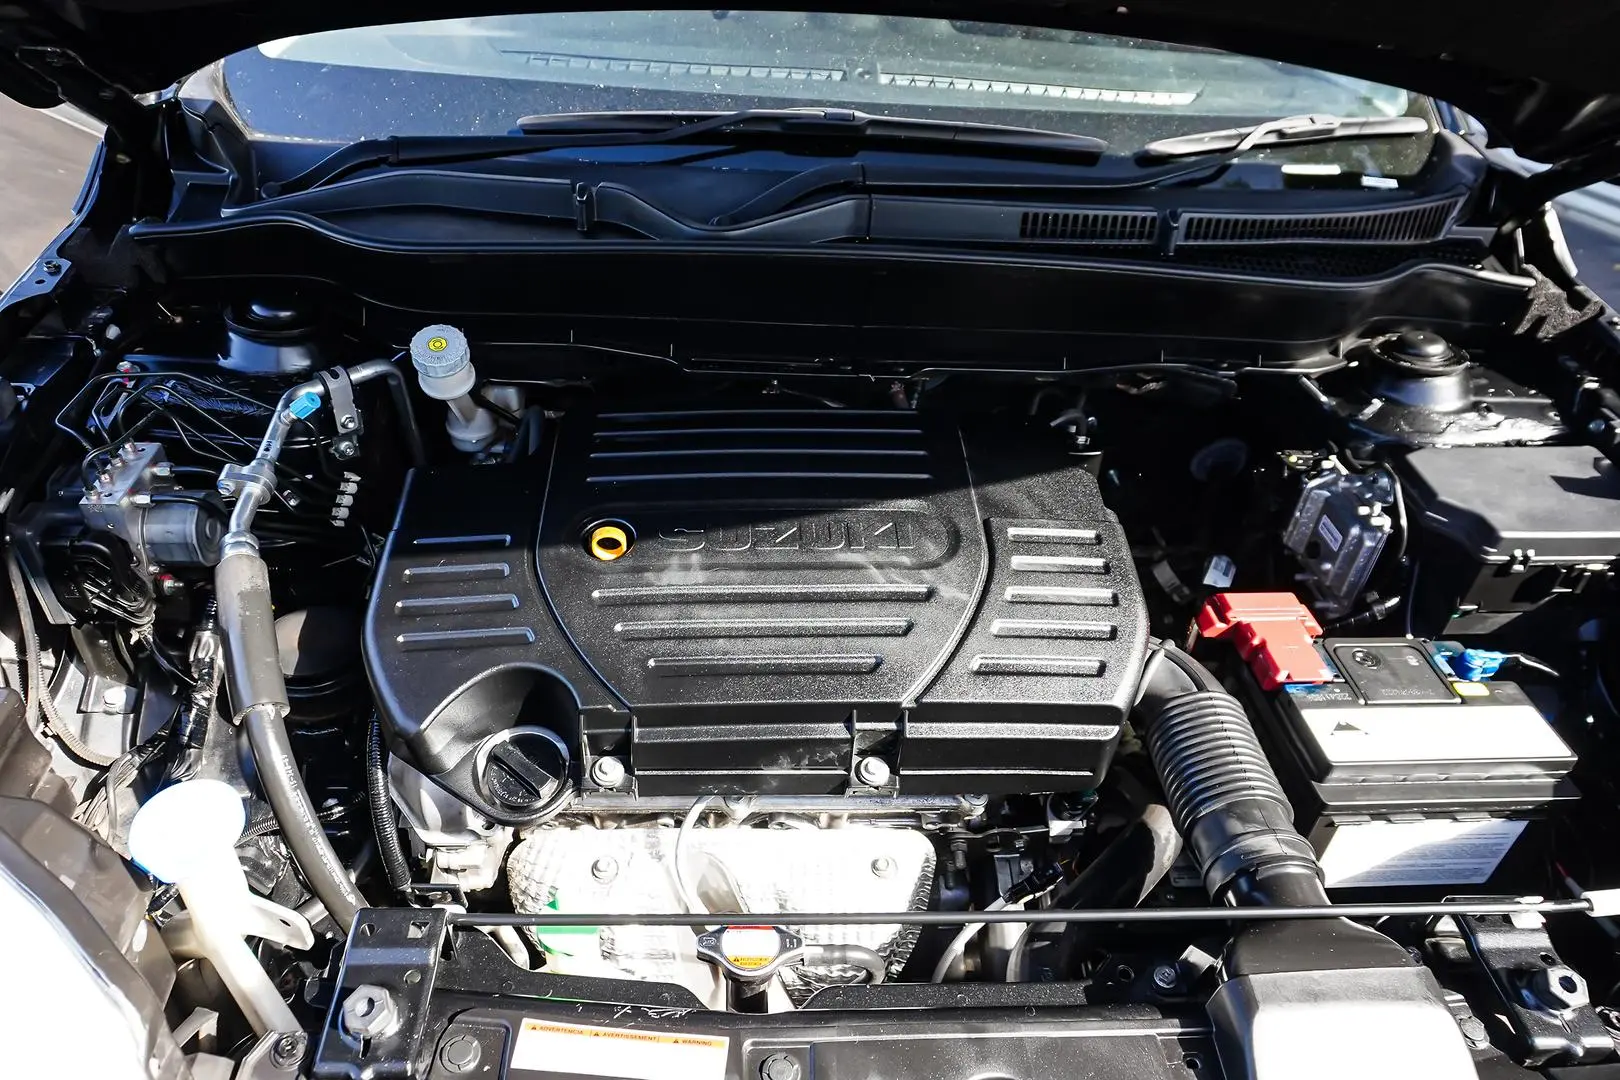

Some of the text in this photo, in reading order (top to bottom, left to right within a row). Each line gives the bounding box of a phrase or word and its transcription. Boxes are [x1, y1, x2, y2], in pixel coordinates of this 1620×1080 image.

[657, 521, 915, 551] SUZUKI
[539, 1026, 584, 1035] ADVERTENCIA
[602, 1032, 657, 1041] AVERTISSEMENT
[681, 1039, 712, 1047] WARNING
